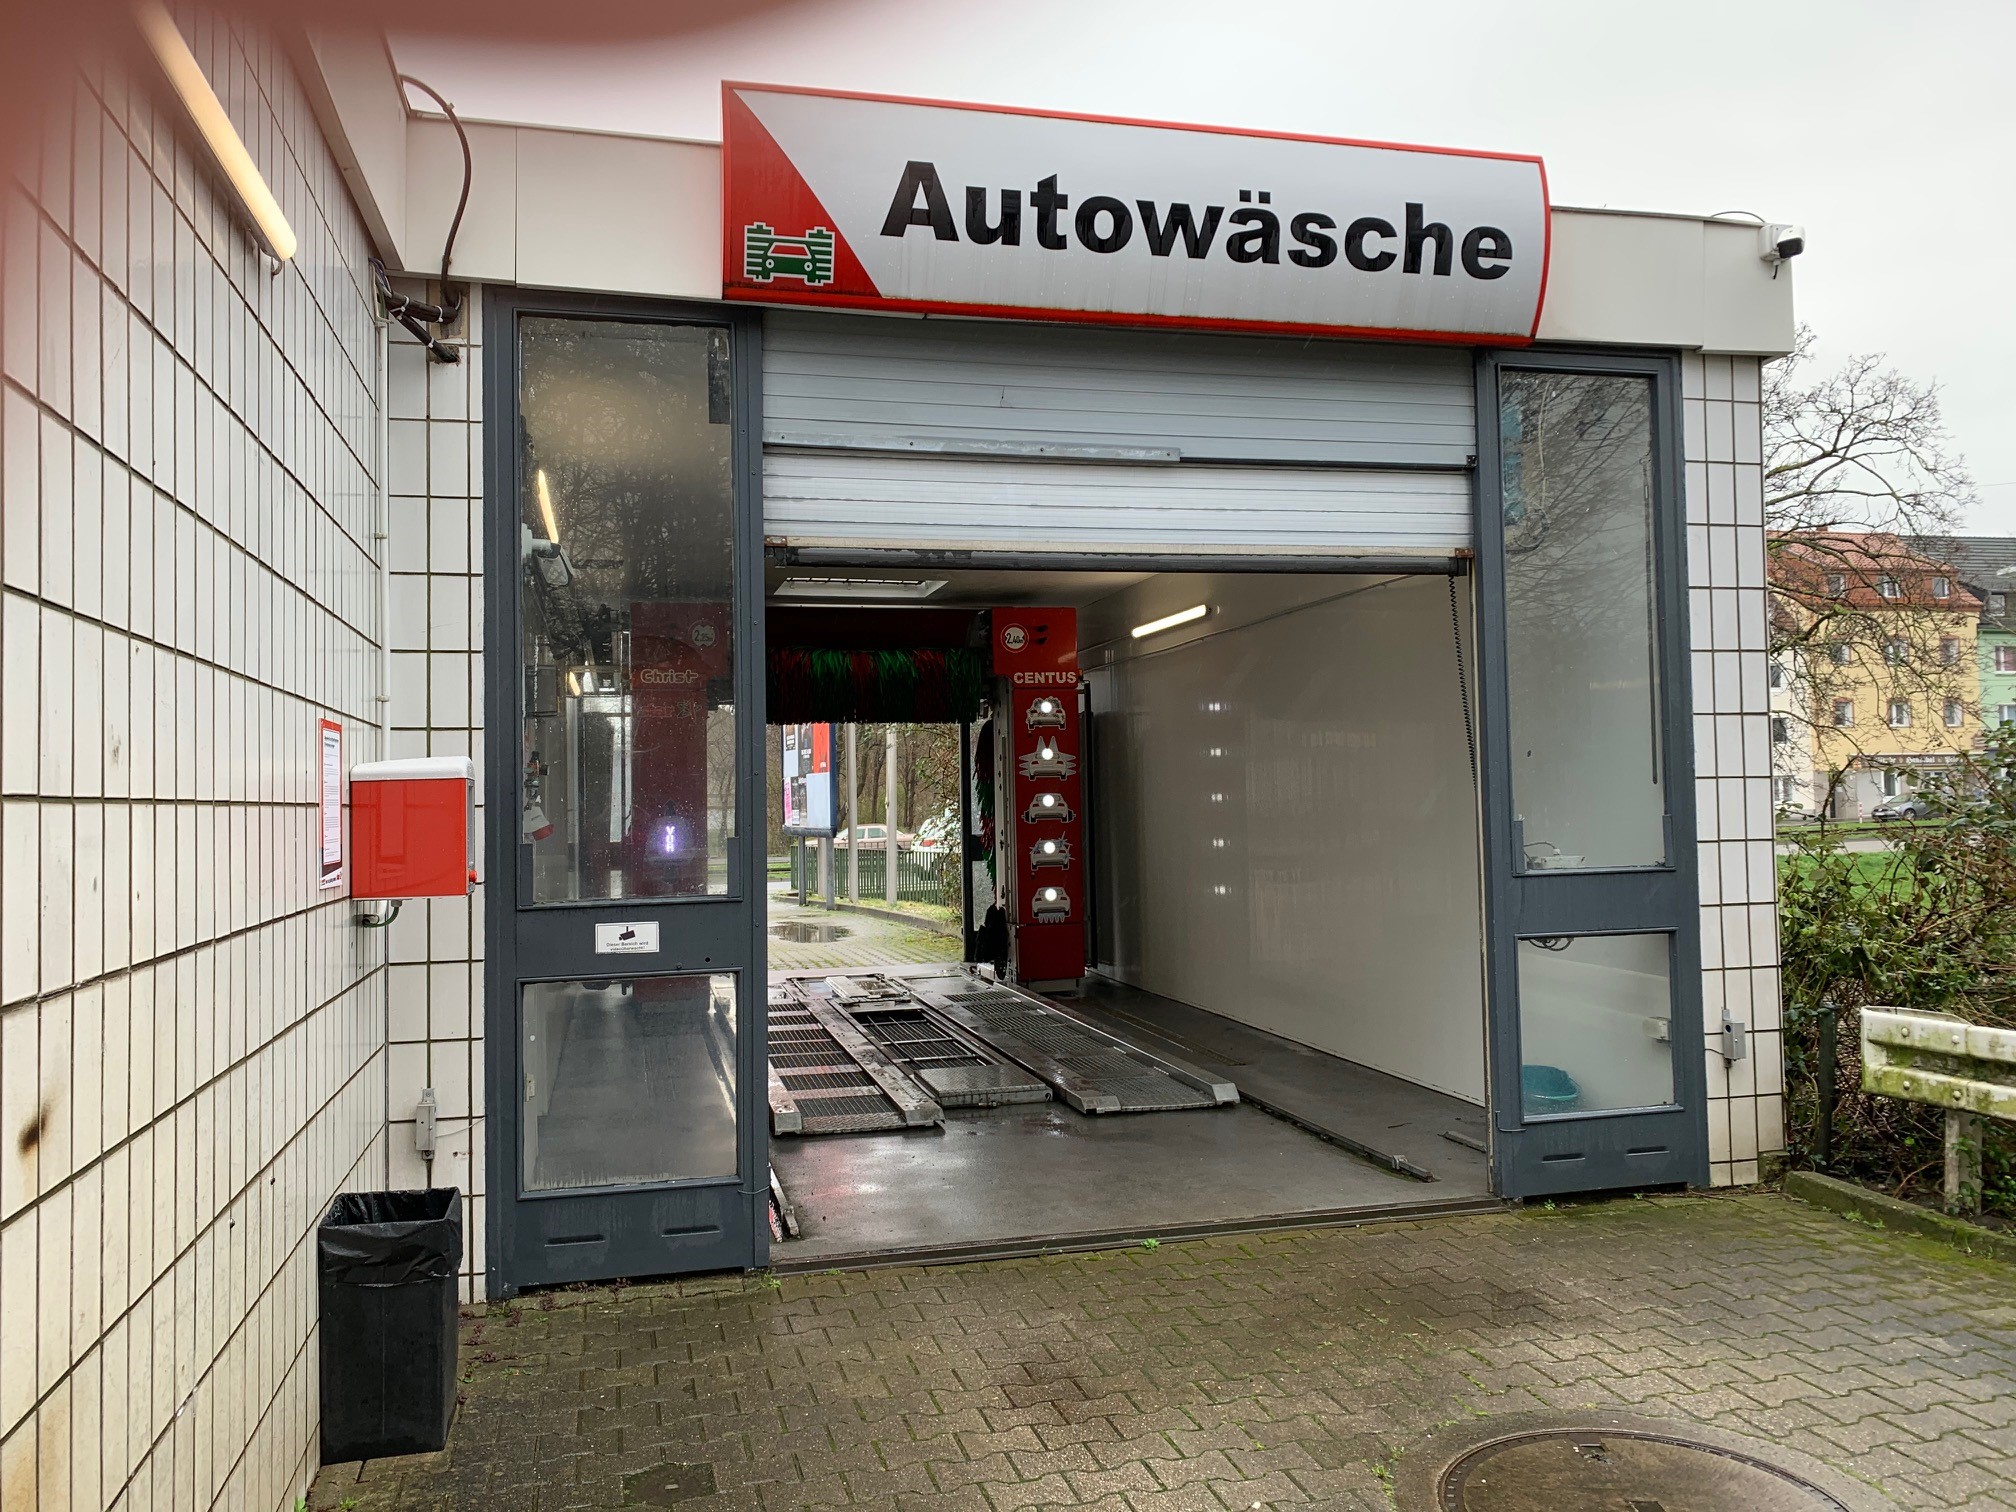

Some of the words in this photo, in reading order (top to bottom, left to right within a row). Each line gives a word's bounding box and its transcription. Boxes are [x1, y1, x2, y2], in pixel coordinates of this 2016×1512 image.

[881, 160, 1514, 280] Autowäsche
[640, 669, 698, 684] Christ
[1013, 672, 1077, 684] CENTUS
